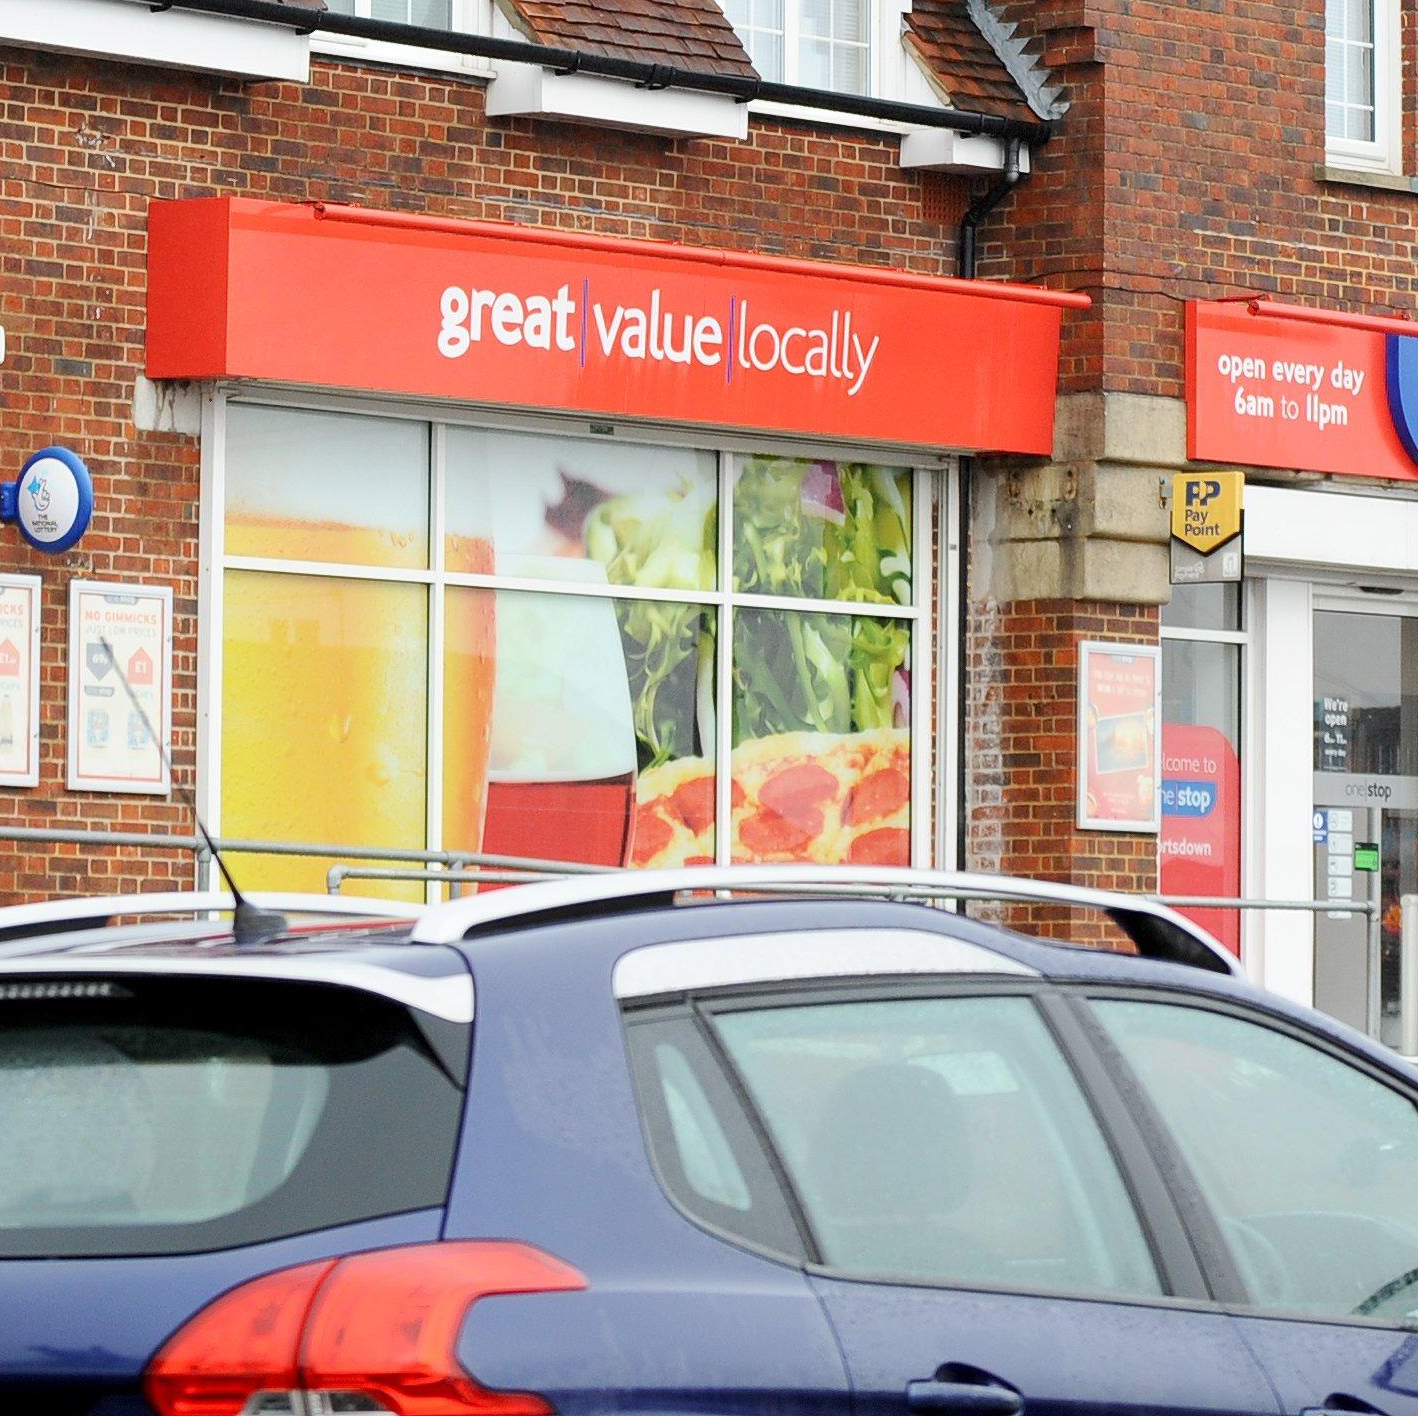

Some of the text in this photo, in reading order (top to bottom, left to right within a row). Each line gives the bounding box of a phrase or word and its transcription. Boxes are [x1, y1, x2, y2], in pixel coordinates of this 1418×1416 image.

[438, 284, 881, 396] great value locally
[1218, 351, 1365, 395] open every day
[1234, 392, 1348, 429] 6am to 11pm
[1185, 509, 1208, 525] Pay
[1185, 523, 1220, 536] Point
[85, 610, 157, 625] NO GIMMICKS
[1324, 697, 1349, 712] We're
[1324, 713, 1348, 727] open
[1203, 757, 1217, 774] to
[1161, 788, 1175, 806] ne
[1178, 787, 1211, 814] stop
[1345, 783, 1392, 803] one stop
[1158, 837, 1212, 857] ortsdown
